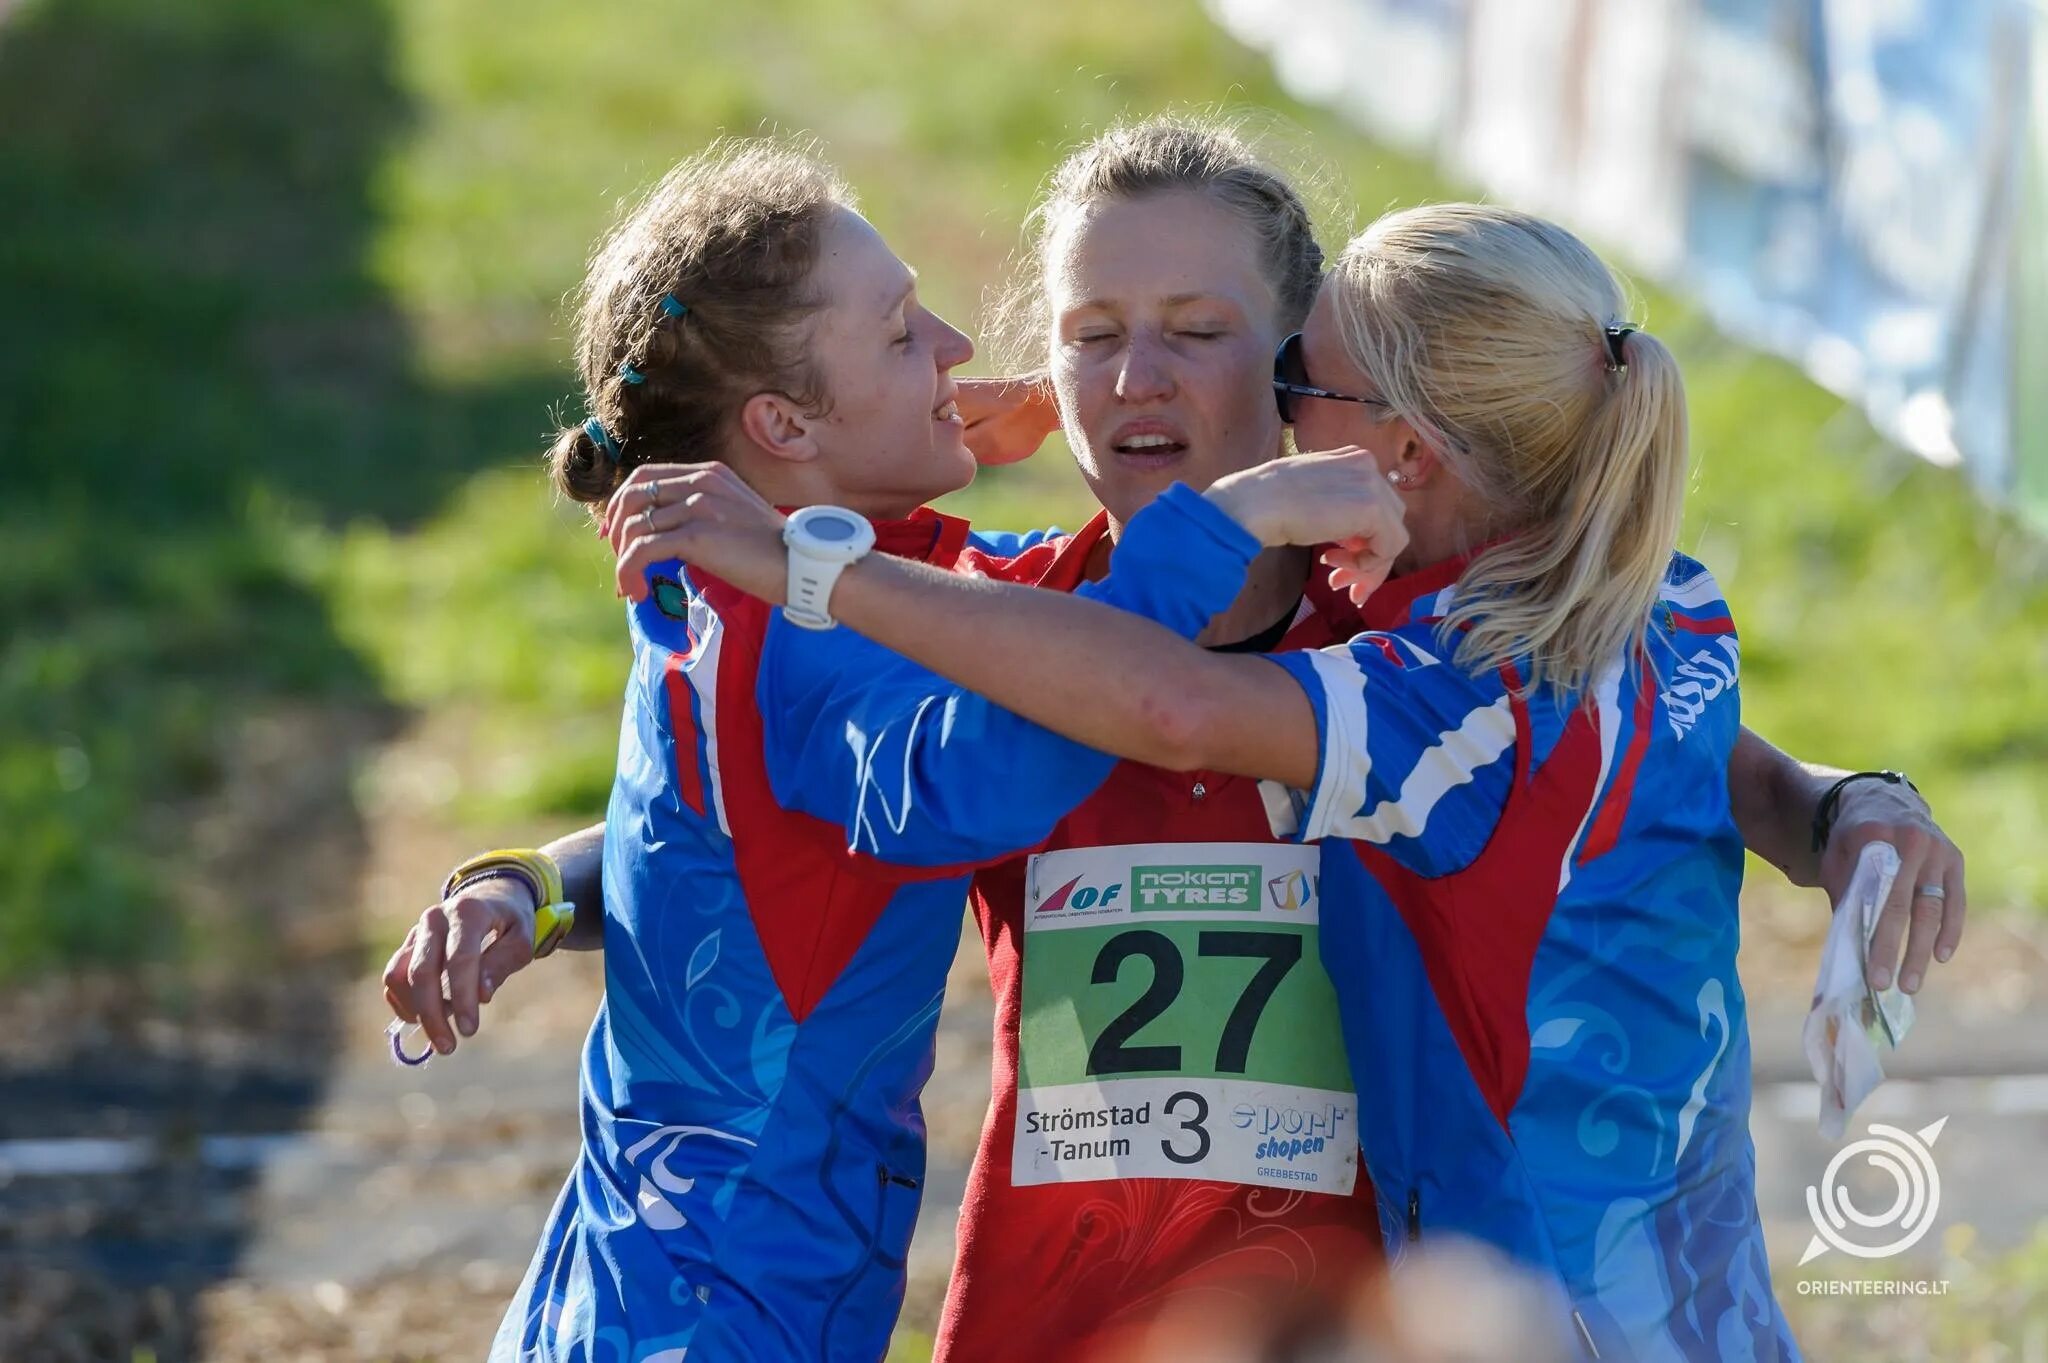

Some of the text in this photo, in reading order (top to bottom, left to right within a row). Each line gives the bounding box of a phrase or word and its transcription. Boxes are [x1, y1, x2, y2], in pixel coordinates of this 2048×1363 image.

[1140, 887, 1249, 904] TYRES
[1085, 929, 1303, 1077] 27
[1026, 1102, 1150, 1134] Strömstad
[1160, 1091, 1211, 1165] 3
[1041, 1138, 1130, 1161] -Tanum
[1256, 1136, 1325, 1161] shopen
[1257, 1167, 1318, 1182] GREBBESTAD
